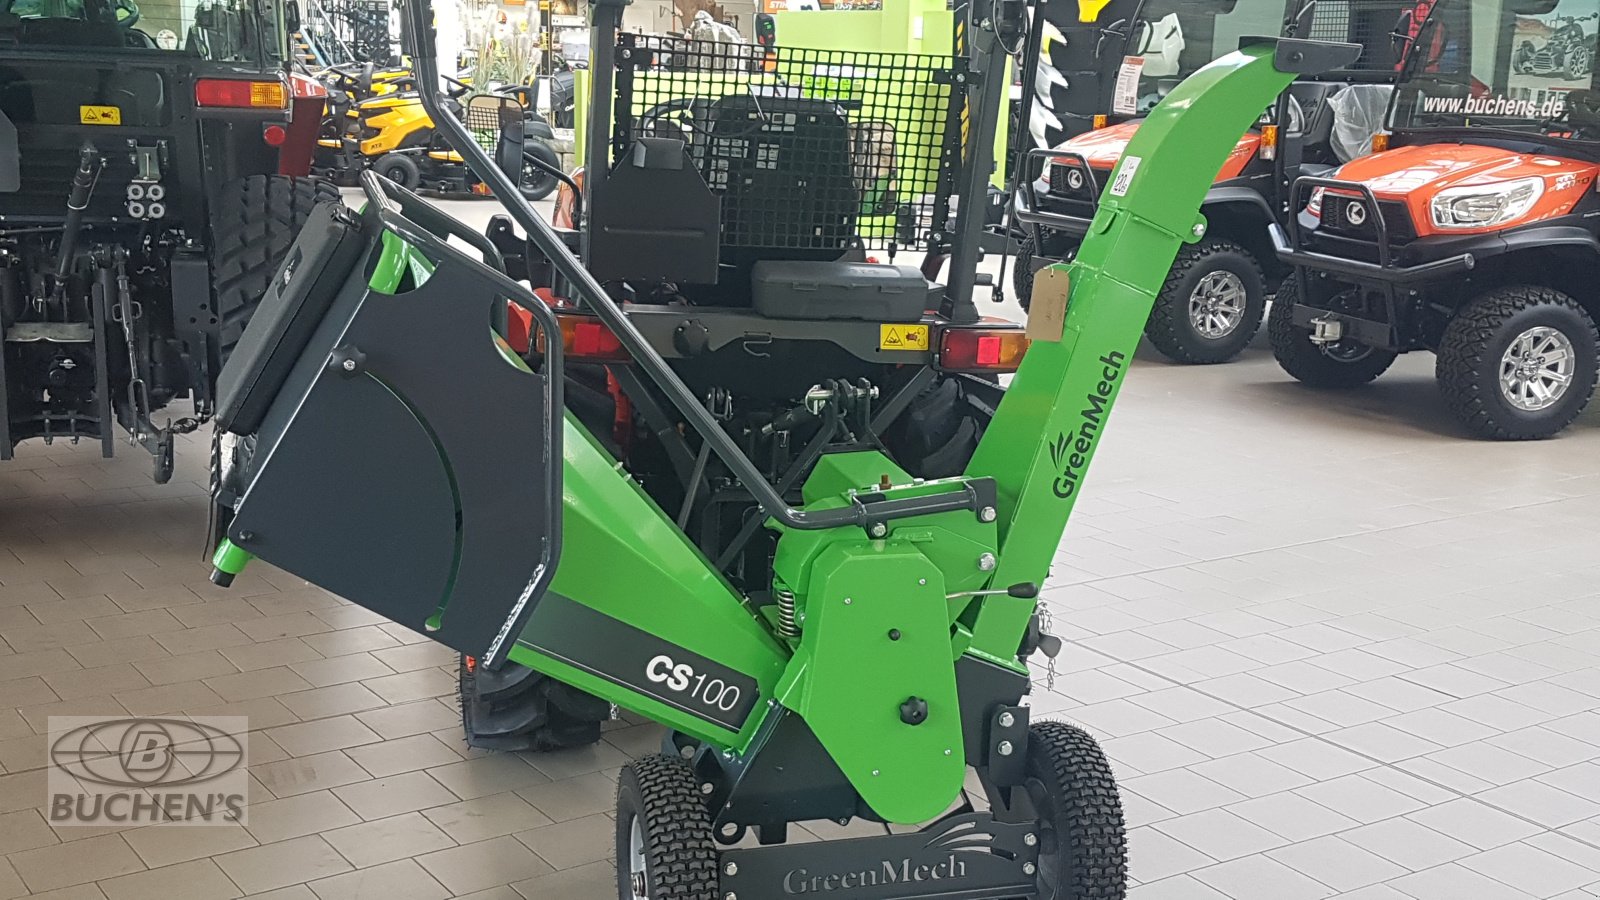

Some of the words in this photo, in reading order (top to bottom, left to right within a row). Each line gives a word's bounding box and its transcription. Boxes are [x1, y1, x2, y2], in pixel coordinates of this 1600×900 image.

[1423, 93, 1564, 118] www.buchens.de
[1052, 350, 1126, 499] GreenMech
[646, 654, 741, 711] CS100
[783, 855, 967, 895] GreenMech
